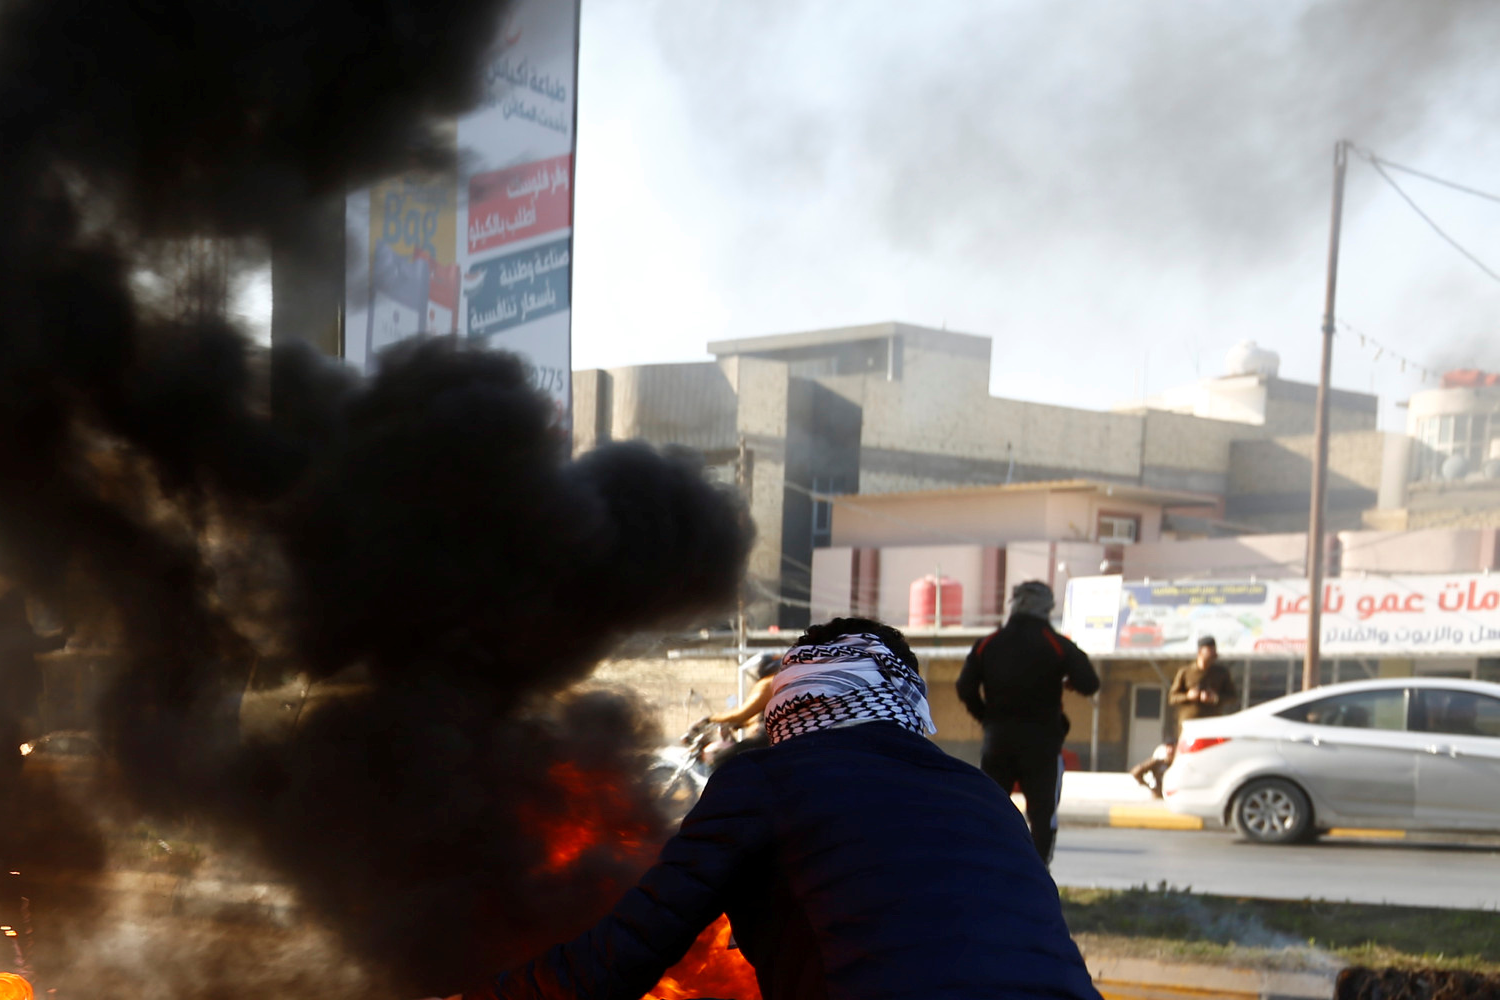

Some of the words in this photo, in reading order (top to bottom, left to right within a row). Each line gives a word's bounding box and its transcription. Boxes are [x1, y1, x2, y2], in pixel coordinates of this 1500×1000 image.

[530, 66, 566, 105] طباعة
[382, 191, 439, 259] Bag
[499, 258, 534, 290] وطنية
[534, 247, 569, 275] صناعة
[470, 293, 516, 333] تنافسية
[1270, 583, 1344, 621] ناصر
[1355, 591, 1426, 620] عمو
[1394, 625, 1464, 645] والزيوت
